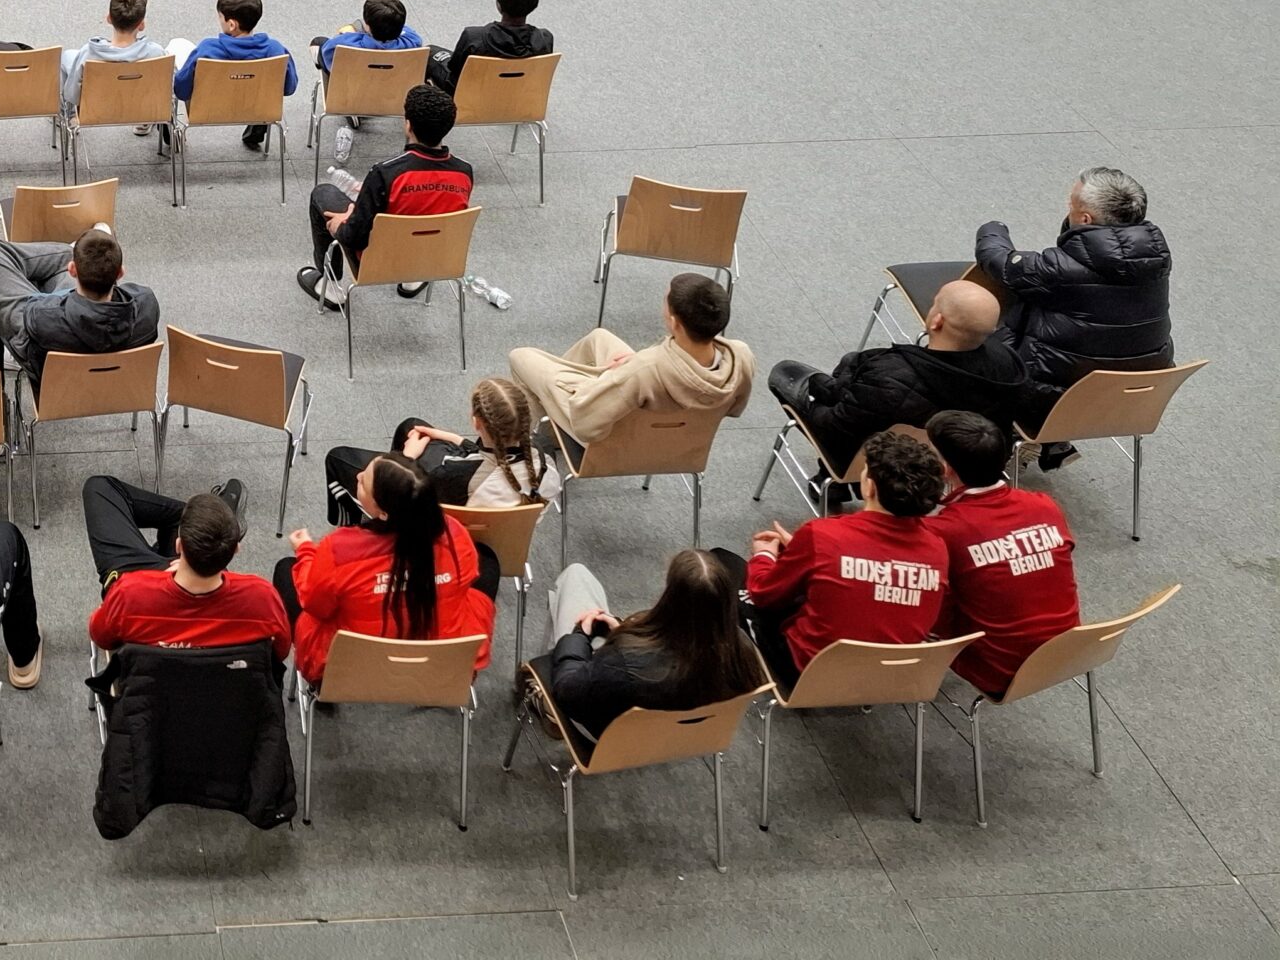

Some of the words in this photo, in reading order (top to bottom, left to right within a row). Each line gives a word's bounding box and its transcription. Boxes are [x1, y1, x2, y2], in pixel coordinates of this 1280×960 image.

[1016, 525, 1065, 555] TEAM
[1009, 550, 1055, 577] BERLIN
[893, 564, 940, 592] TEAM
[874, 584, 922, 607] BERLIN
